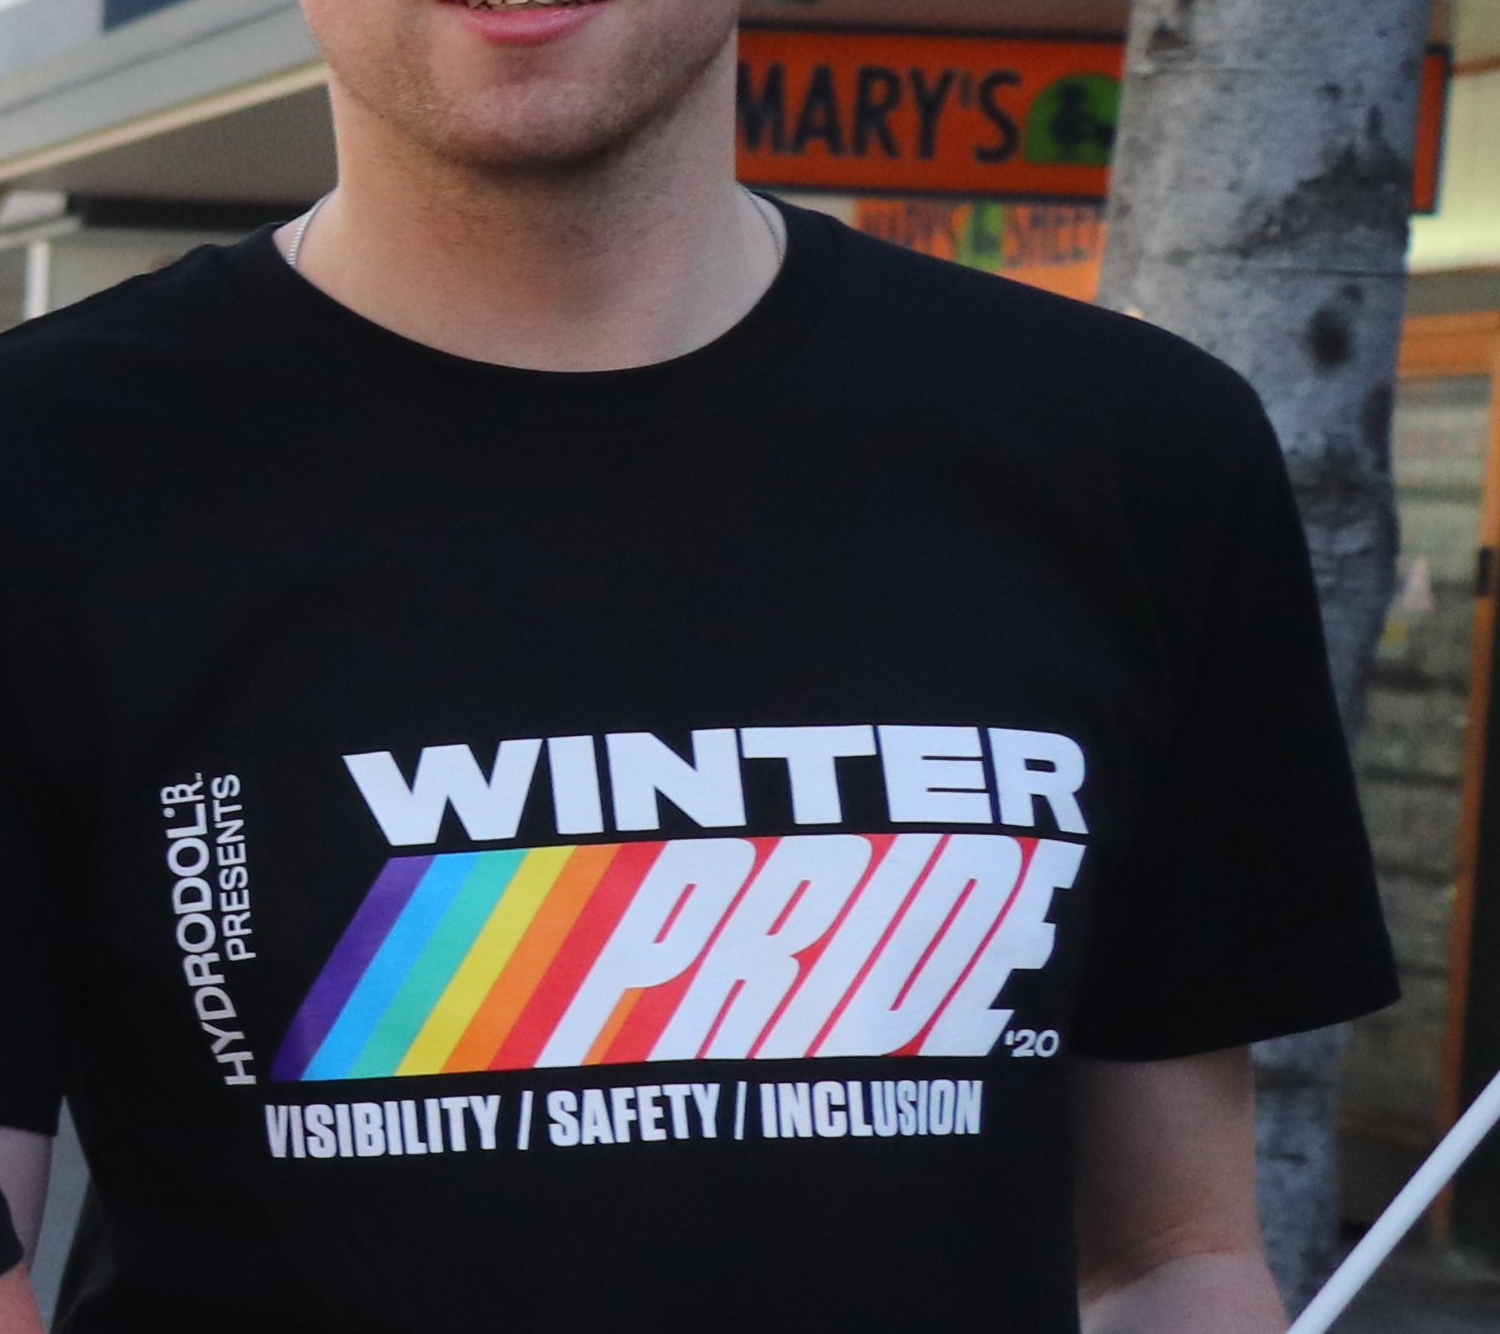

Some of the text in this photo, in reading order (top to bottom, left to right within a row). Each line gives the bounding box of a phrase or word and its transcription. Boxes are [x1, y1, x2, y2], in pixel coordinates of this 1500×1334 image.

[737, 59, 1021, 163] MARY'S
[342, 724, 1090, 847] WINTER
[211, 774, 257, 961] PRESENTS
[534, 833, 1086, 1069] PRIDE
[264, 1094, 501, 1159] VISIBILITY
[546, 1083, 721, 1147] SAFETY
[759, 1078, 984, 1139] INCLUSION
